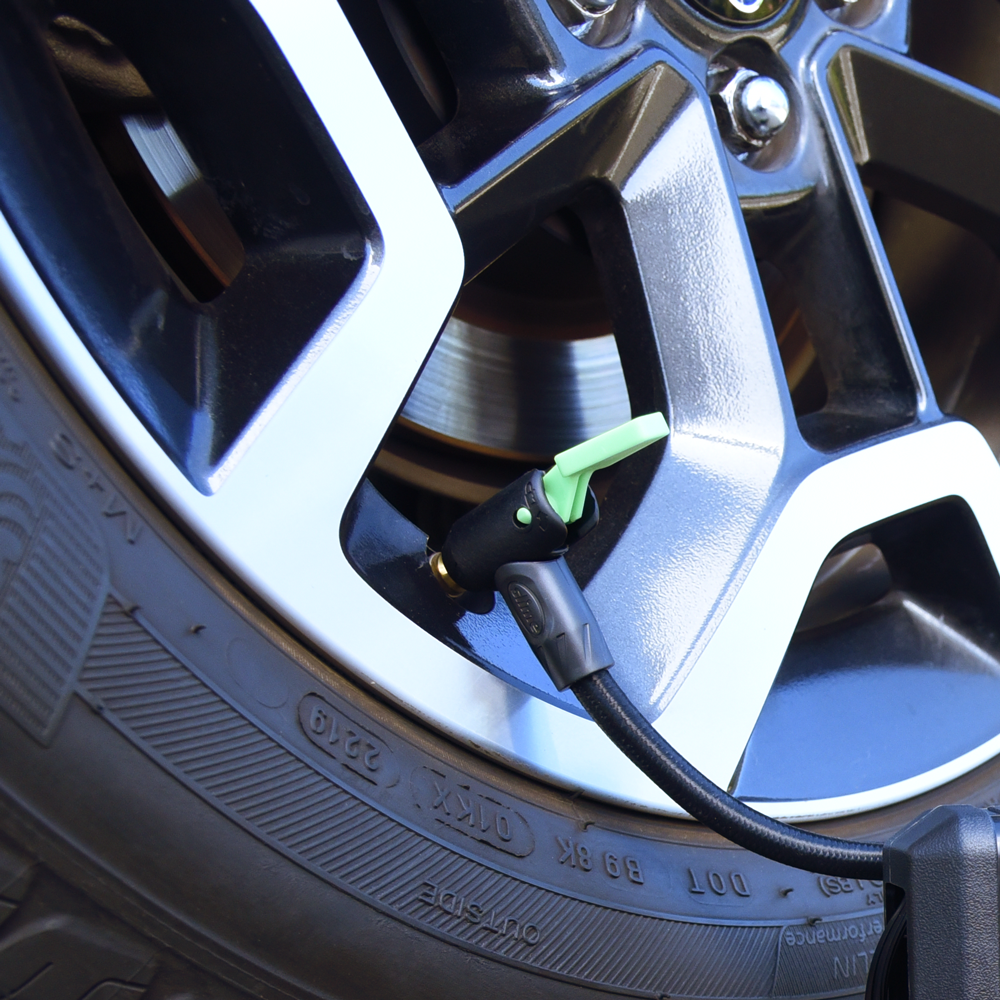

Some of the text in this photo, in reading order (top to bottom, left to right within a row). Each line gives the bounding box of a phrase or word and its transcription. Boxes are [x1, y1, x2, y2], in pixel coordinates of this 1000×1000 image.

[308, 703, 382, 772] 2219
[688, 865, 751, 898] DOT
[418, 879, 543, 948] OUTSIDE
[785, 919, 883, 946] erformance
